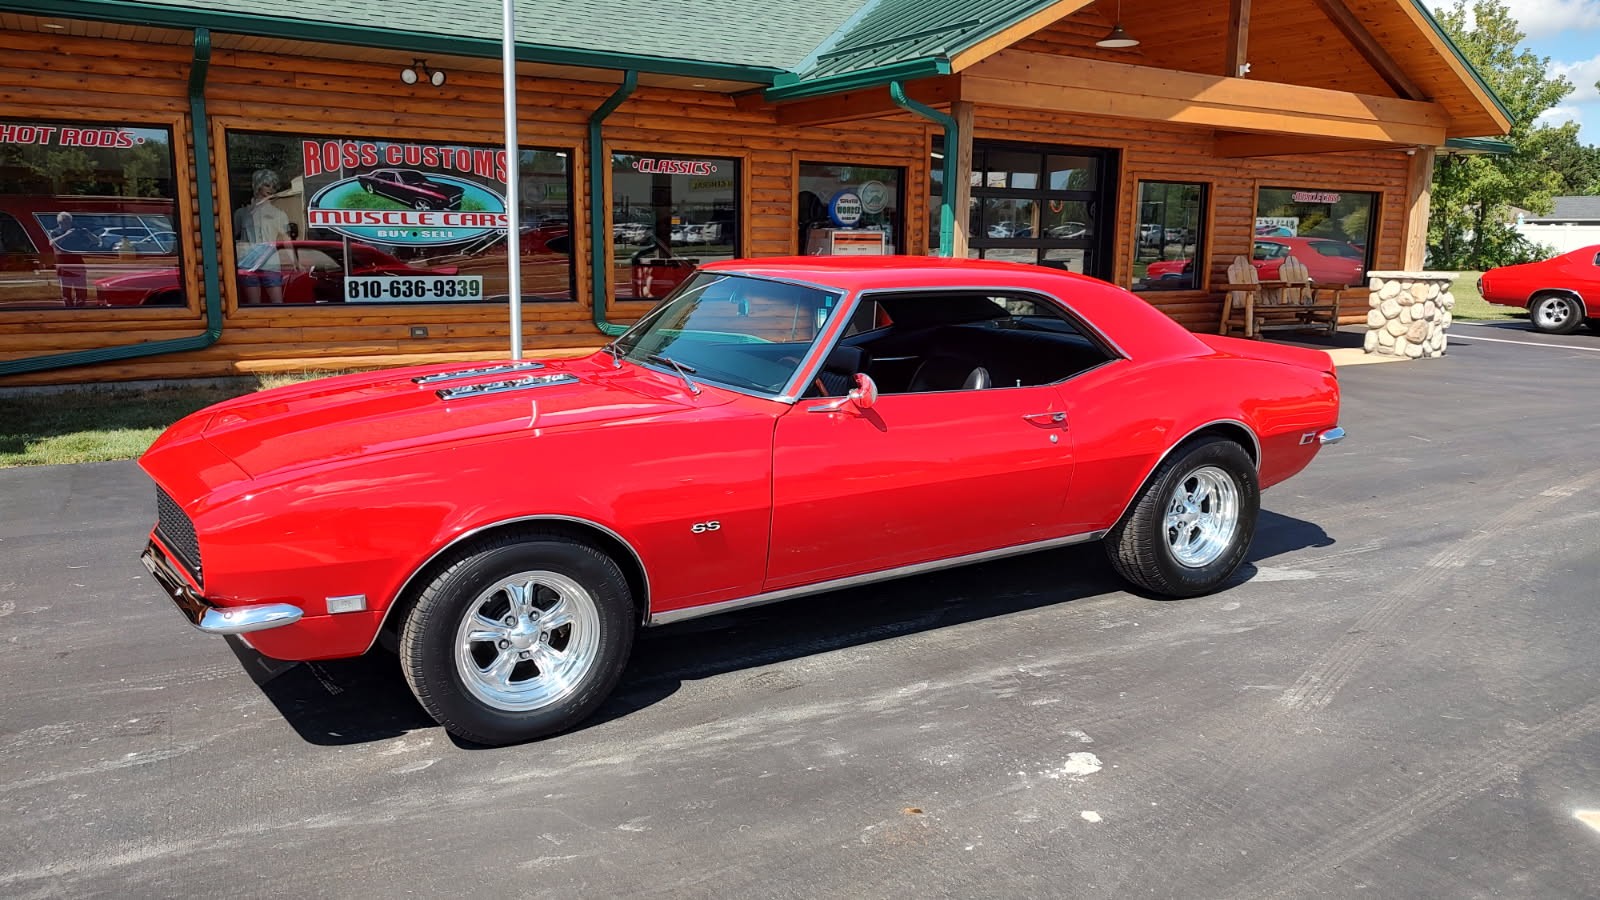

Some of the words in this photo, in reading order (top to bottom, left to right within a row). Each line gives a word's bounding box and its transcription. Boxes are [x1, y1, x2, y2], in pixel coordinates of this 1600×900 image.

[0, 124, 57, 145] HOT
[59, 127, 136, 149] RODS
[303, 140, 378, 179] ROSS
[385, 145, 508, 184] CUSTOMS
[638, 158, 711, 176] CLASSICS
[309, 210, 435, 226] MUSCLE
[443, 213, 509, 227] CARS
[377, 230, 409, 238] BUY
[421, 231, 455, 239] SELL
[348, 279, 480, 299] 810-636-9339
[691, 520, 721, 533] SS
